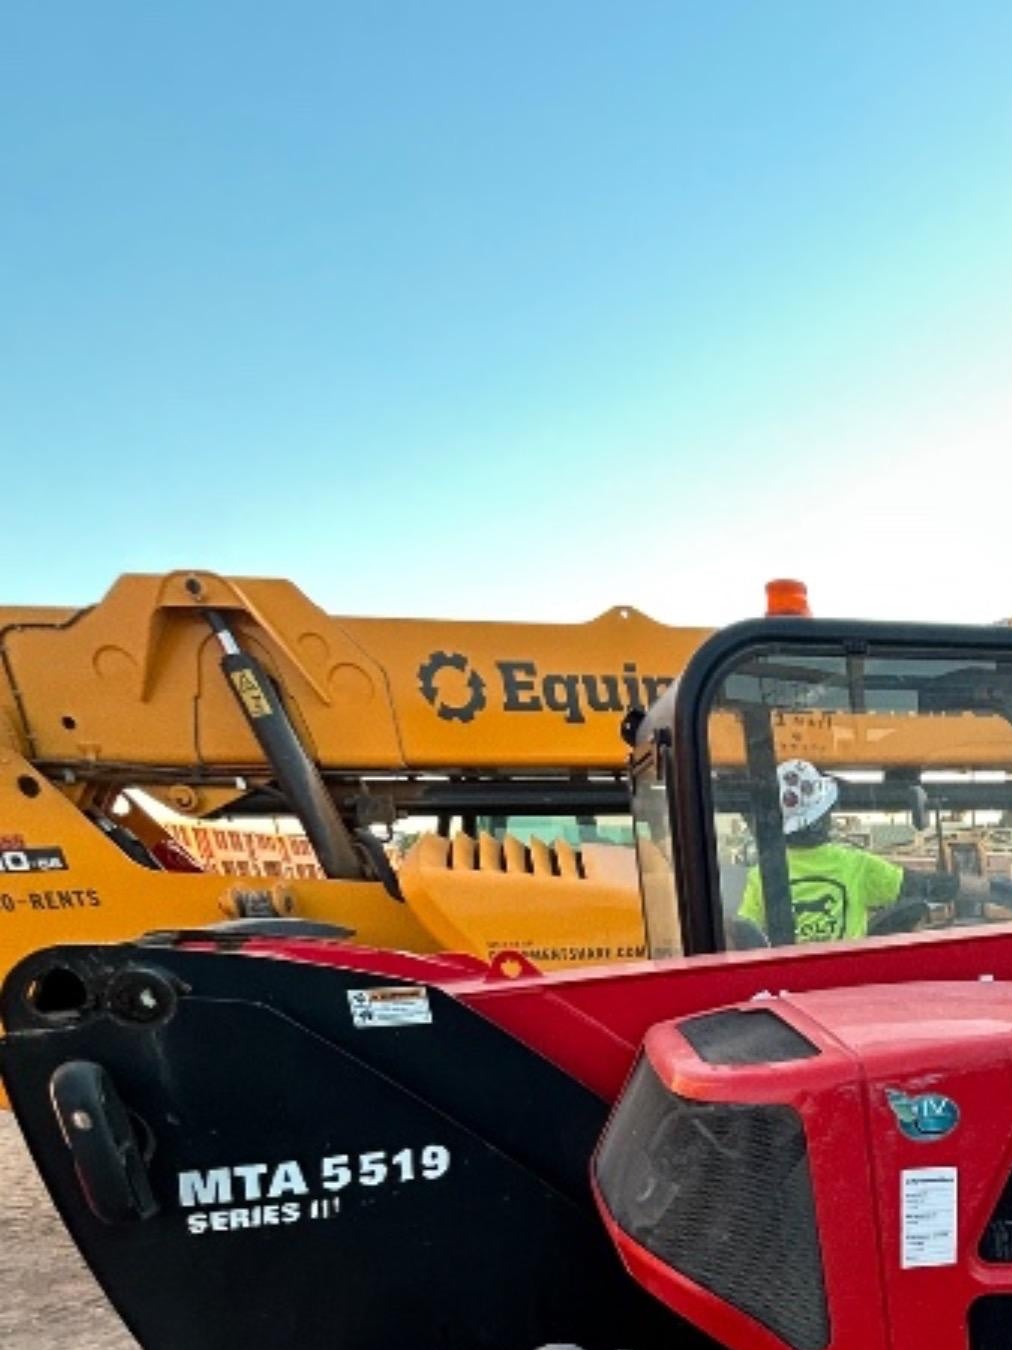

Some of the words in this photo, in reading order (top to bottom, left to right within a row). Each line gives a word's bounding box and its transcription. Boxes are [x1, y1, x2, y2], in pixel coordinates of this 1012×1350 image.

[0, 888, 100, 912] 0-RENTS
[799, 919, 838, 937] OLT
[178, 1160, 309, 1207] MTA
[321, 1144, 451, 1191] 5519
[186, 1202, 301, 1234] SERIES
